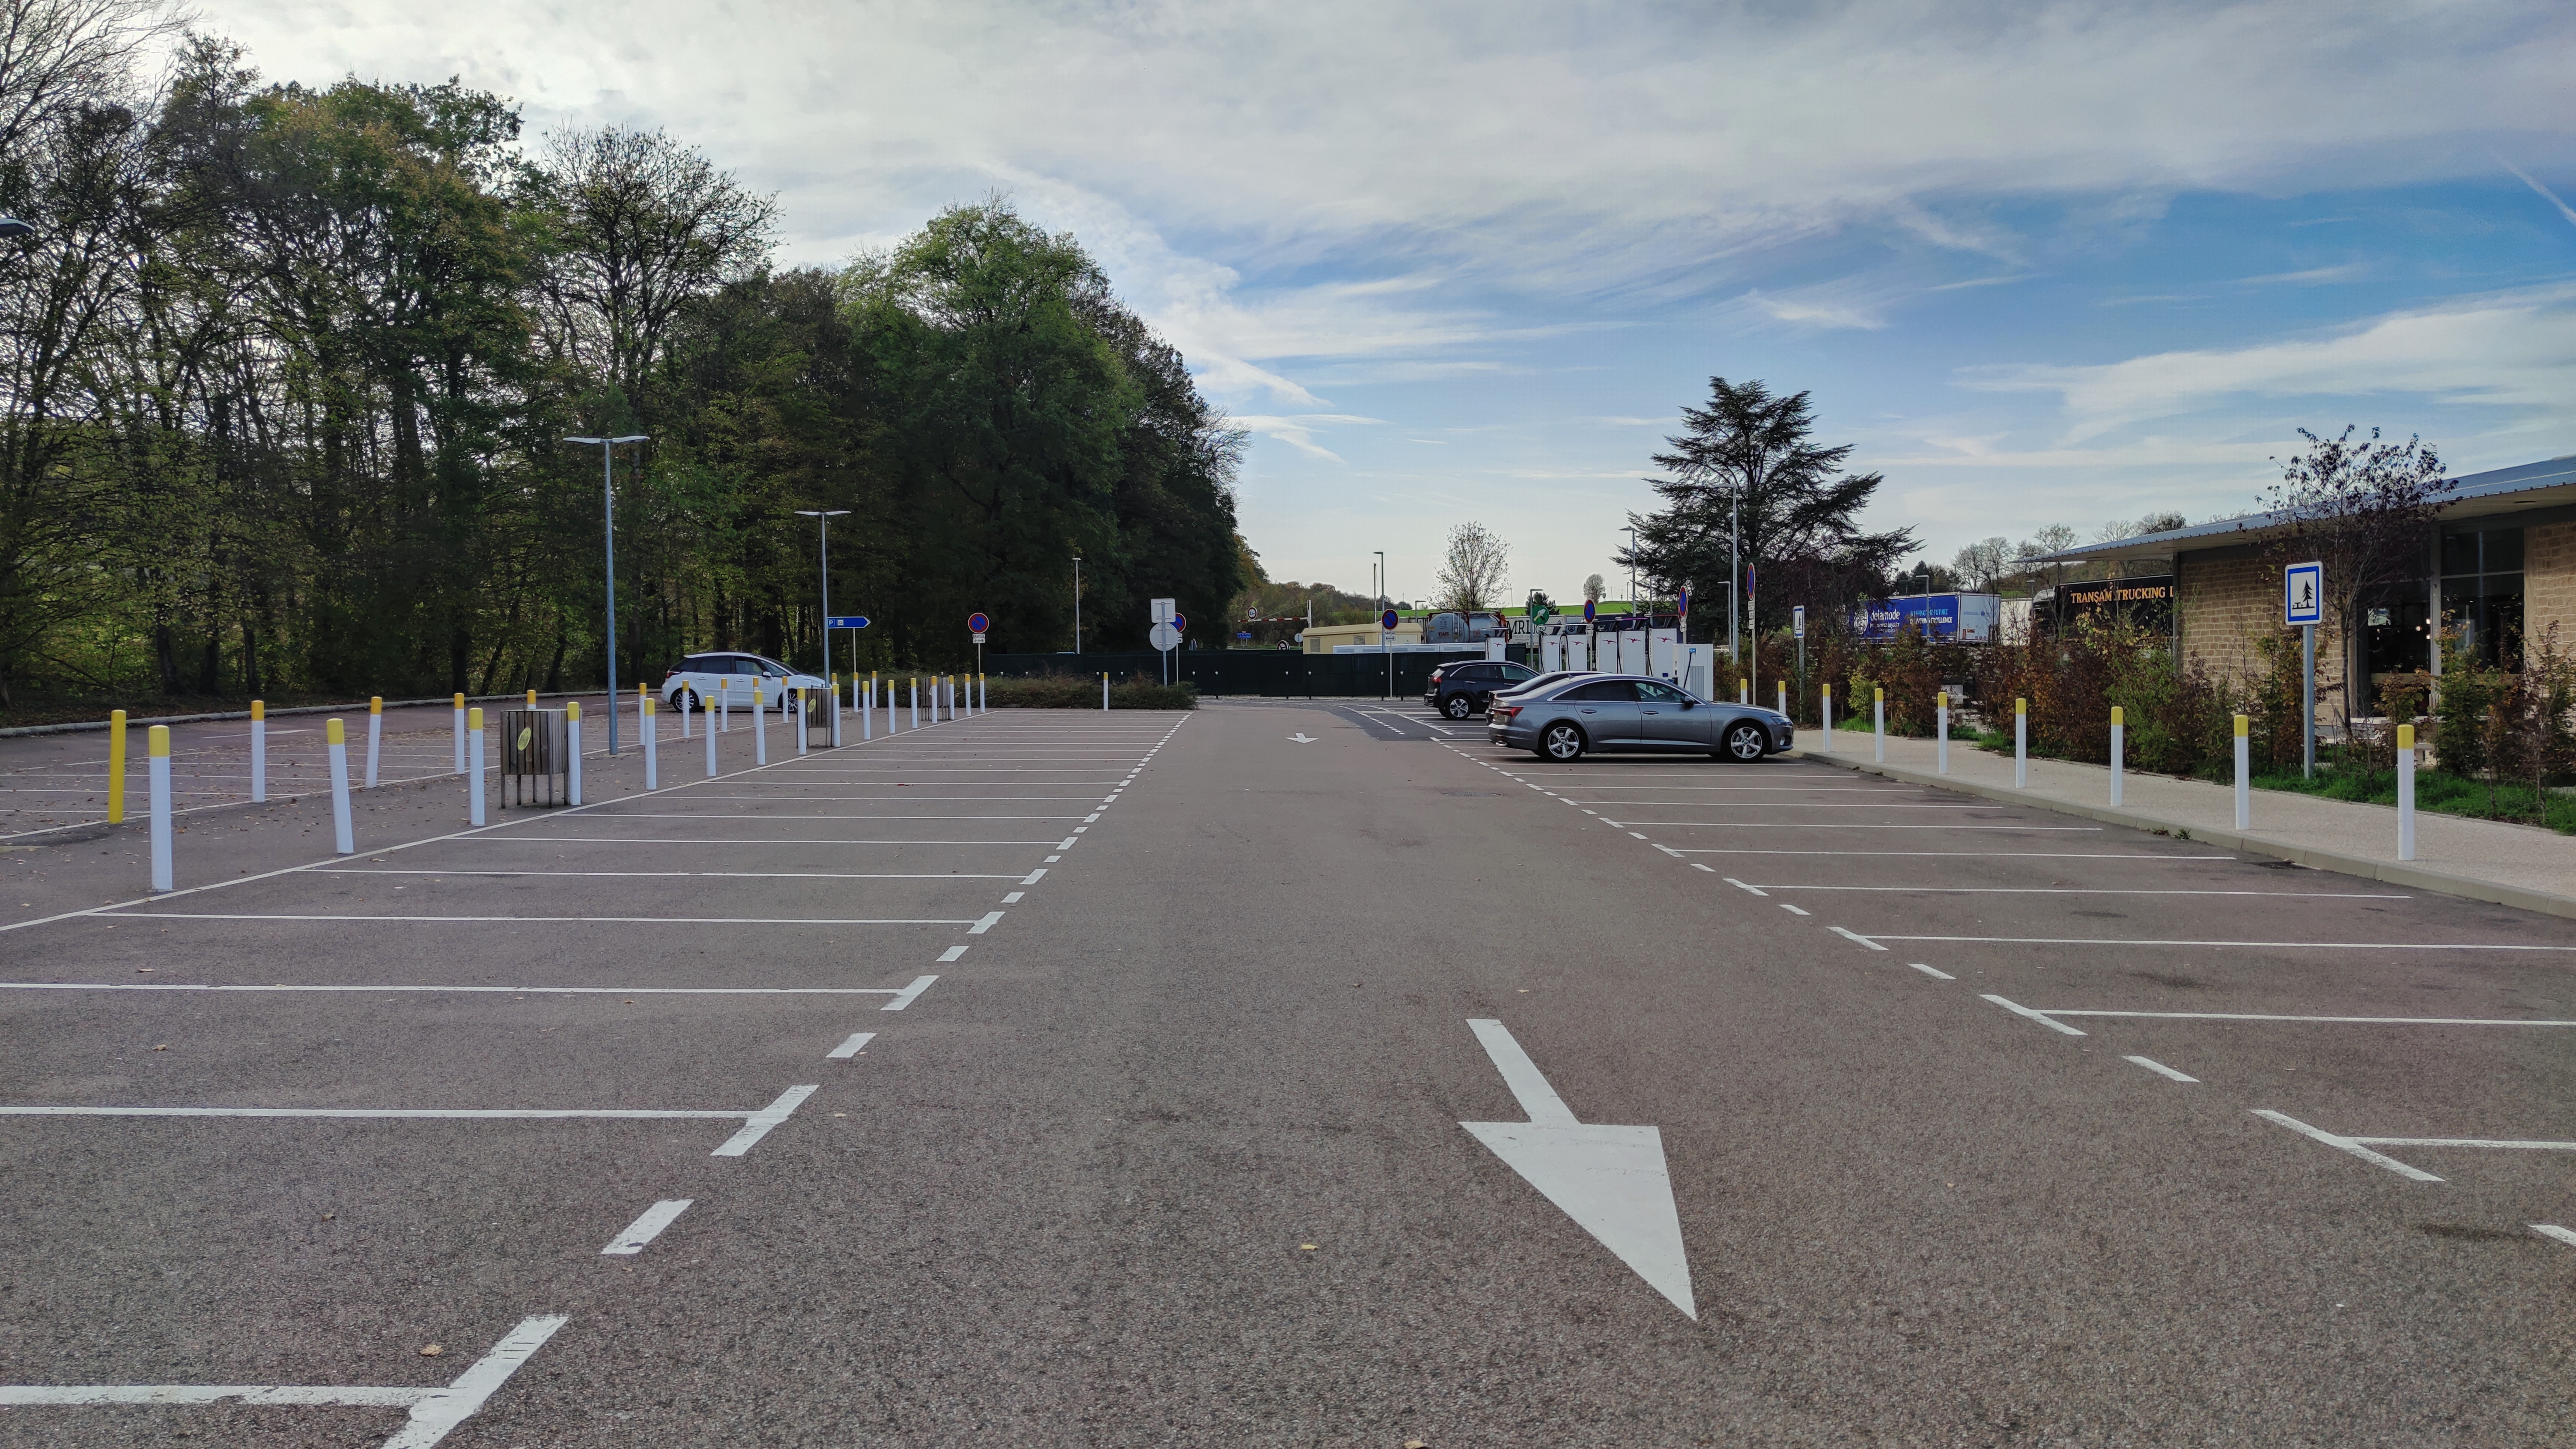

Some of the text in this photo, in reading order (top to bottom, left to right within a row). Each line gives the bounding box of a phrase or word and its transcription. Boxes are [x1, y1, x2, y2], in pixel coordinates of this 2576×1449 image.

[2071, 590, 2112, 603] TRANSAM
[2117, 586, 2166, 601] TRUCKING
[1870, 608, 1900, 621] delamode
